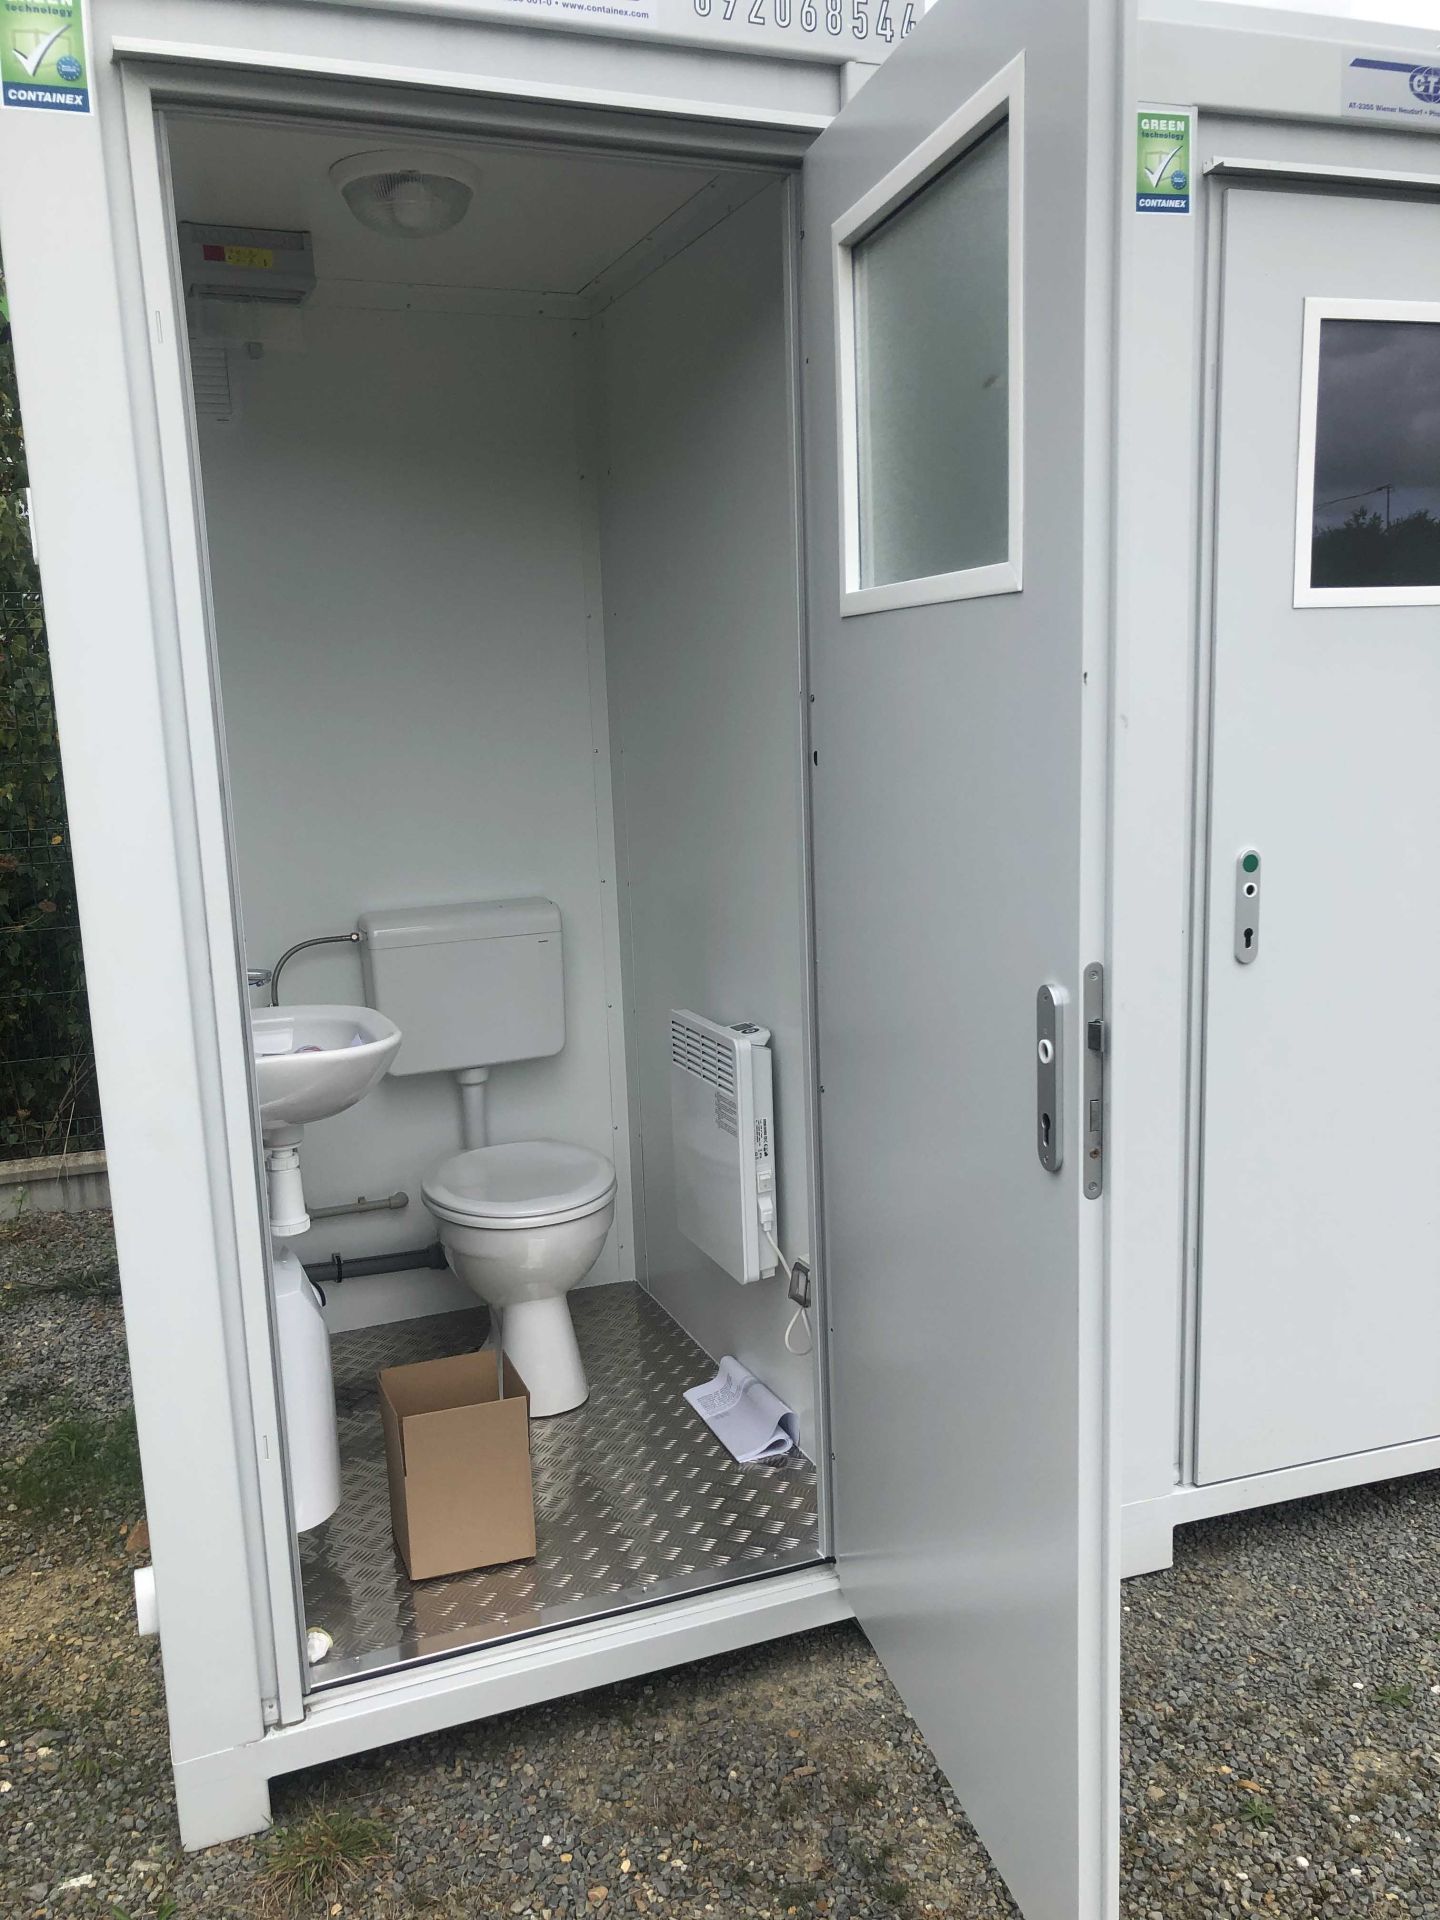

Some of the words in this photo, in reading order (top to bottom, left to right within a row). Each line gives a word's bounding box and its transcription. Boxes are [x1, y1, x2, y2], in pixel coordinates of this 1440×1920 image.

[5, 4, 73, 18] technology
[562, 2, 649, 19] www.containex.com
[8, 89, 83, 105] CONTAINEX
[1141, 119, 1185, 131] GREEN
[1141, 131, 1184, 140] technology
[1139, 198, 1186, 208] CONTAINEX
